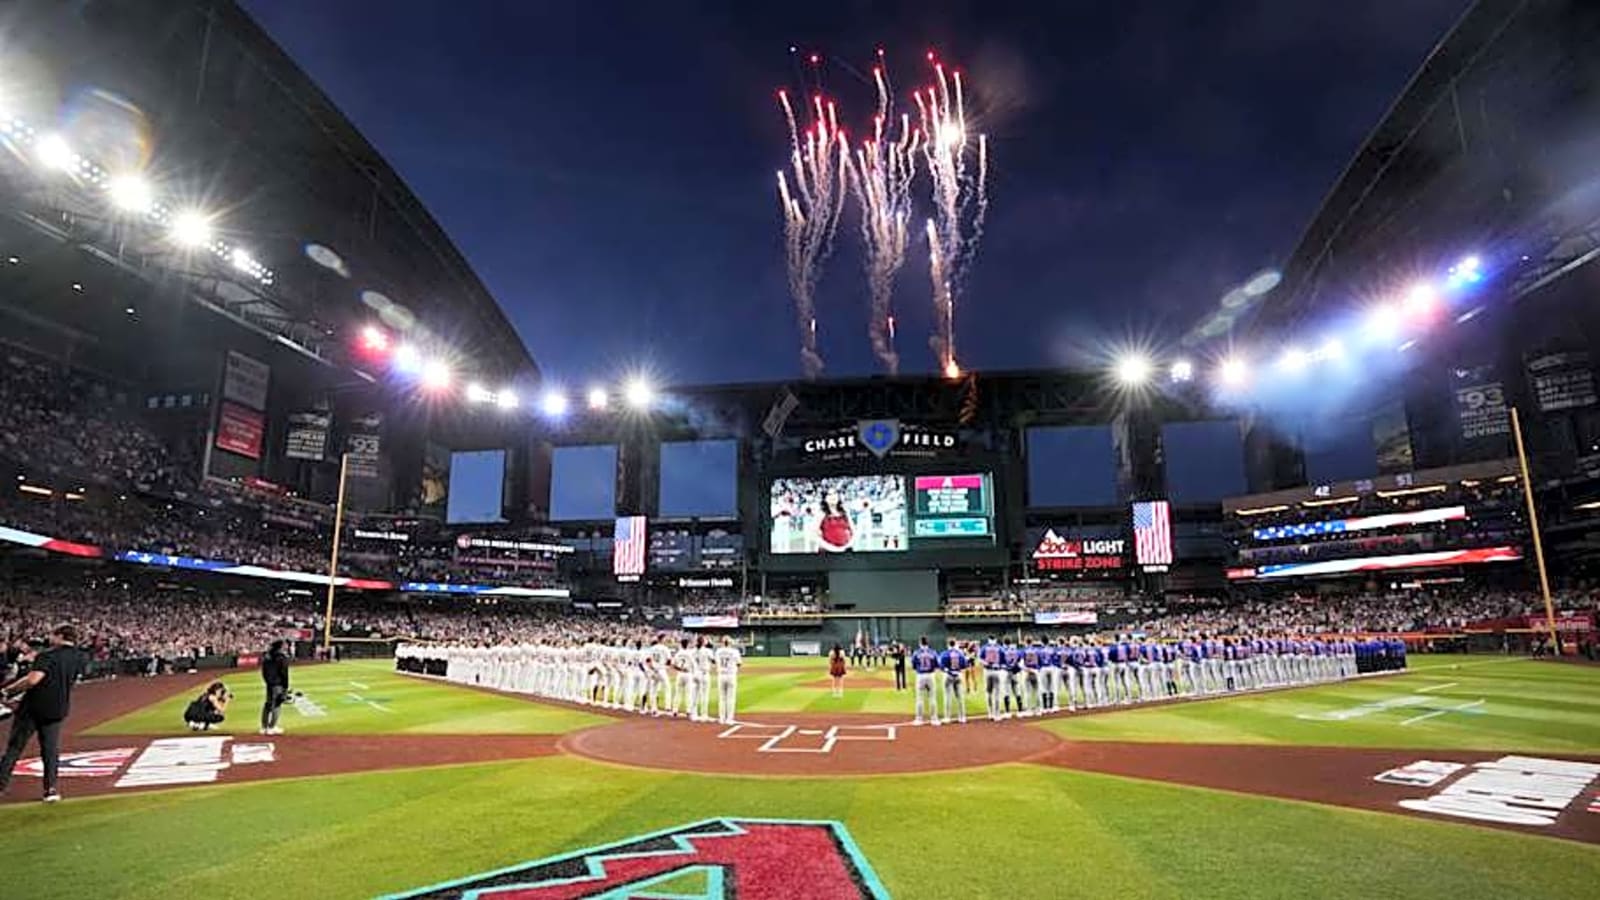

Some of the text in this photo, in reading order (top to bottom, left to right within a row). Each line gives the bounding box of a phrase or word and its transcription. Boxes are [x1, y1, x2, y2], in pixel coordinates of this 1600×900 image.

[804, 434, 955, 452] CHASE FIELD
[1315, 485, 1330, 496] 42
[1039, 537, 1125, 554] Coors LIGHT
[1037, 557, 1122, 570] STRIKE ZONE
